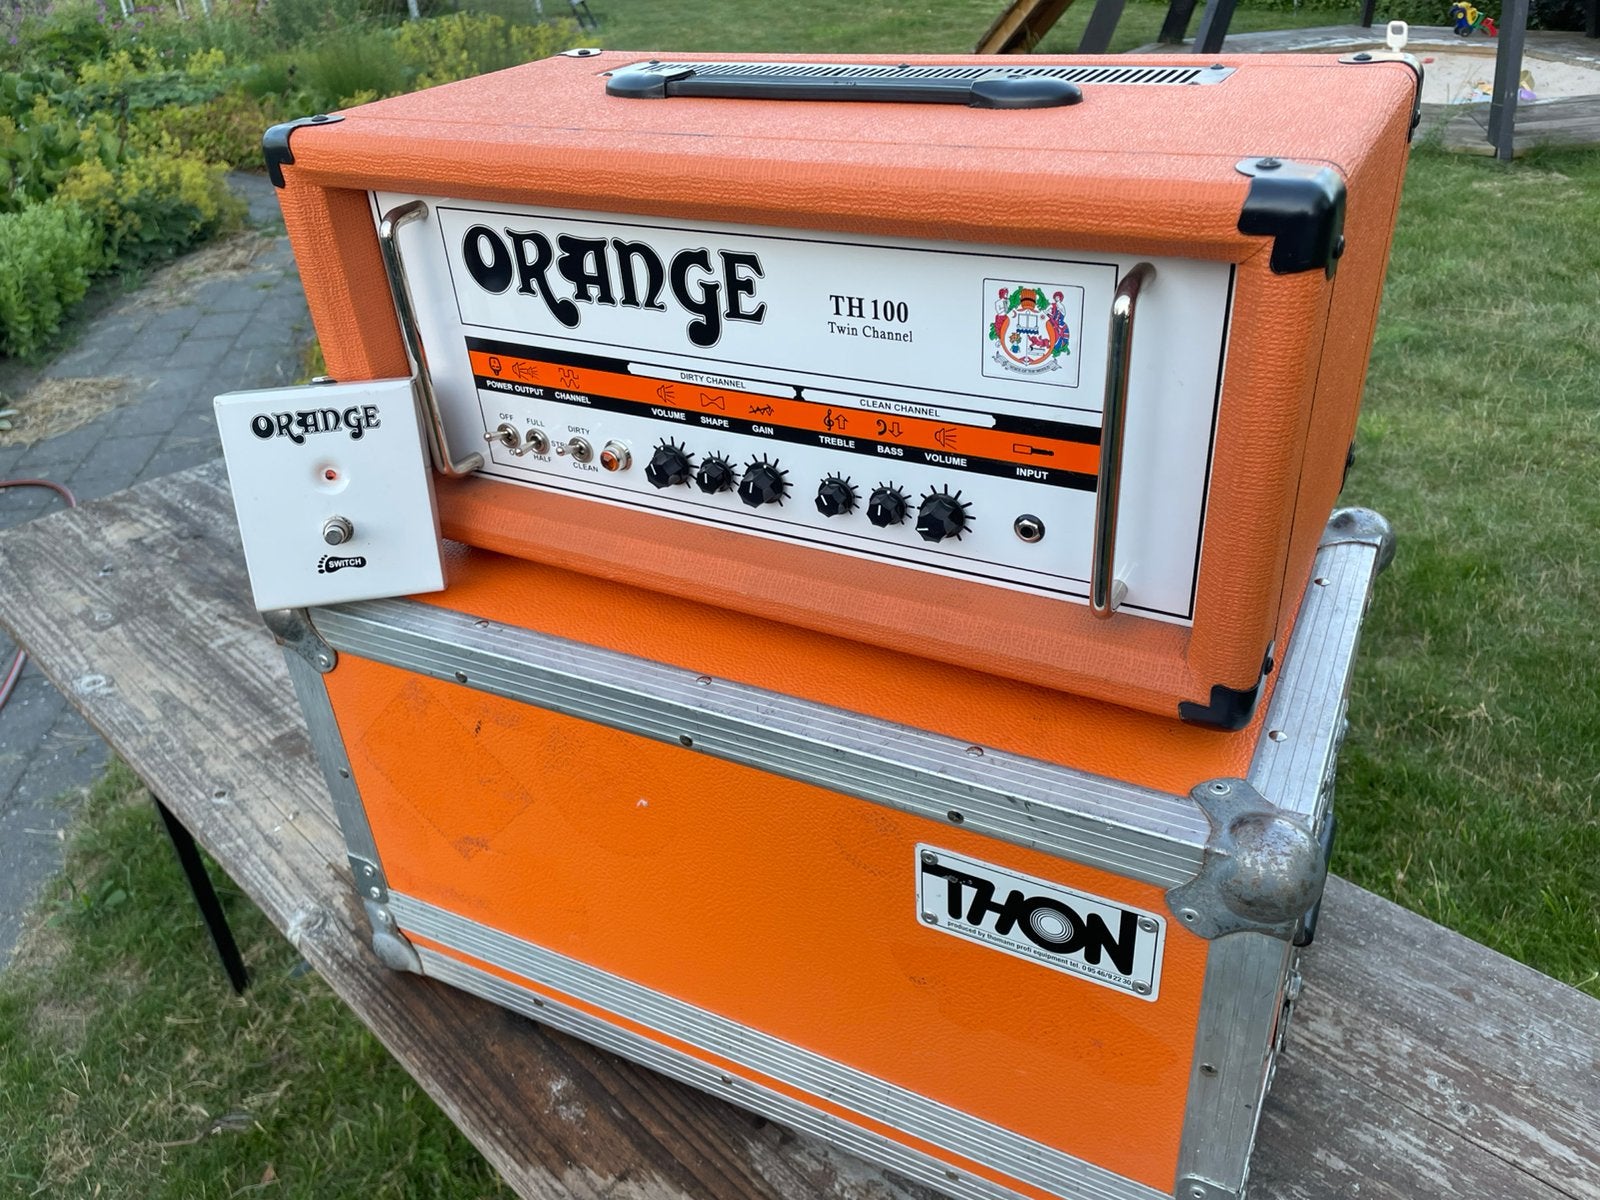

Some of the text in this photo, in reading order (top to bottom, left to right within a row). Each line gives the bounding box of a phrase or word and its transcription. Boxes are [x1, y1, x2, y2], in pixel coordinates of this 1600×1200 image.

[461, 224, 767, 348] ORANGE
[829, 294, 909, 324] TH 100
[828, 321, 913, 342] Twin Channel
[680, 372, 746, 389] DIRTY CHANNEL
[486, 380, 544, 396] POWER OUTPUT
[554, 391, 592, 404] CHANNEL
[651, 407, 686, 421] VOLUME
[859, 398, 940, 418] CLEAN CHANNEL
[499, 412, 514, 421] OFF
[526, 418, 545, 427] FULL
[700, 416, 729, 428] SHAPE
[251, 403, 381, 446] ORANGE
[567, 425, 590, 435] DIRTY
[751, 424, 774, 436] GAIN
[818, 435, 856, 449] TREBLE
[877, 445, 904, 457] BASS
[533, 454, 552, 463] HALF
[924, 452, 968, 467] VOLUME
[572, 461, 599, 473] CLEAN
[1016, 467, 1049, 480] INPUT
[328, 556, 362, 569] SWITCH
[922, 860, 1139, 976] THON
[947, 921, 977, 935] produced
[977, 930, 986, 938] by
[987, 933, 1015, 947] thomann
[1016, 943, 1032, 953] profi
[1033, 948, 1068, 965] equipment
[1069, 961, 1080, 969] tel.
